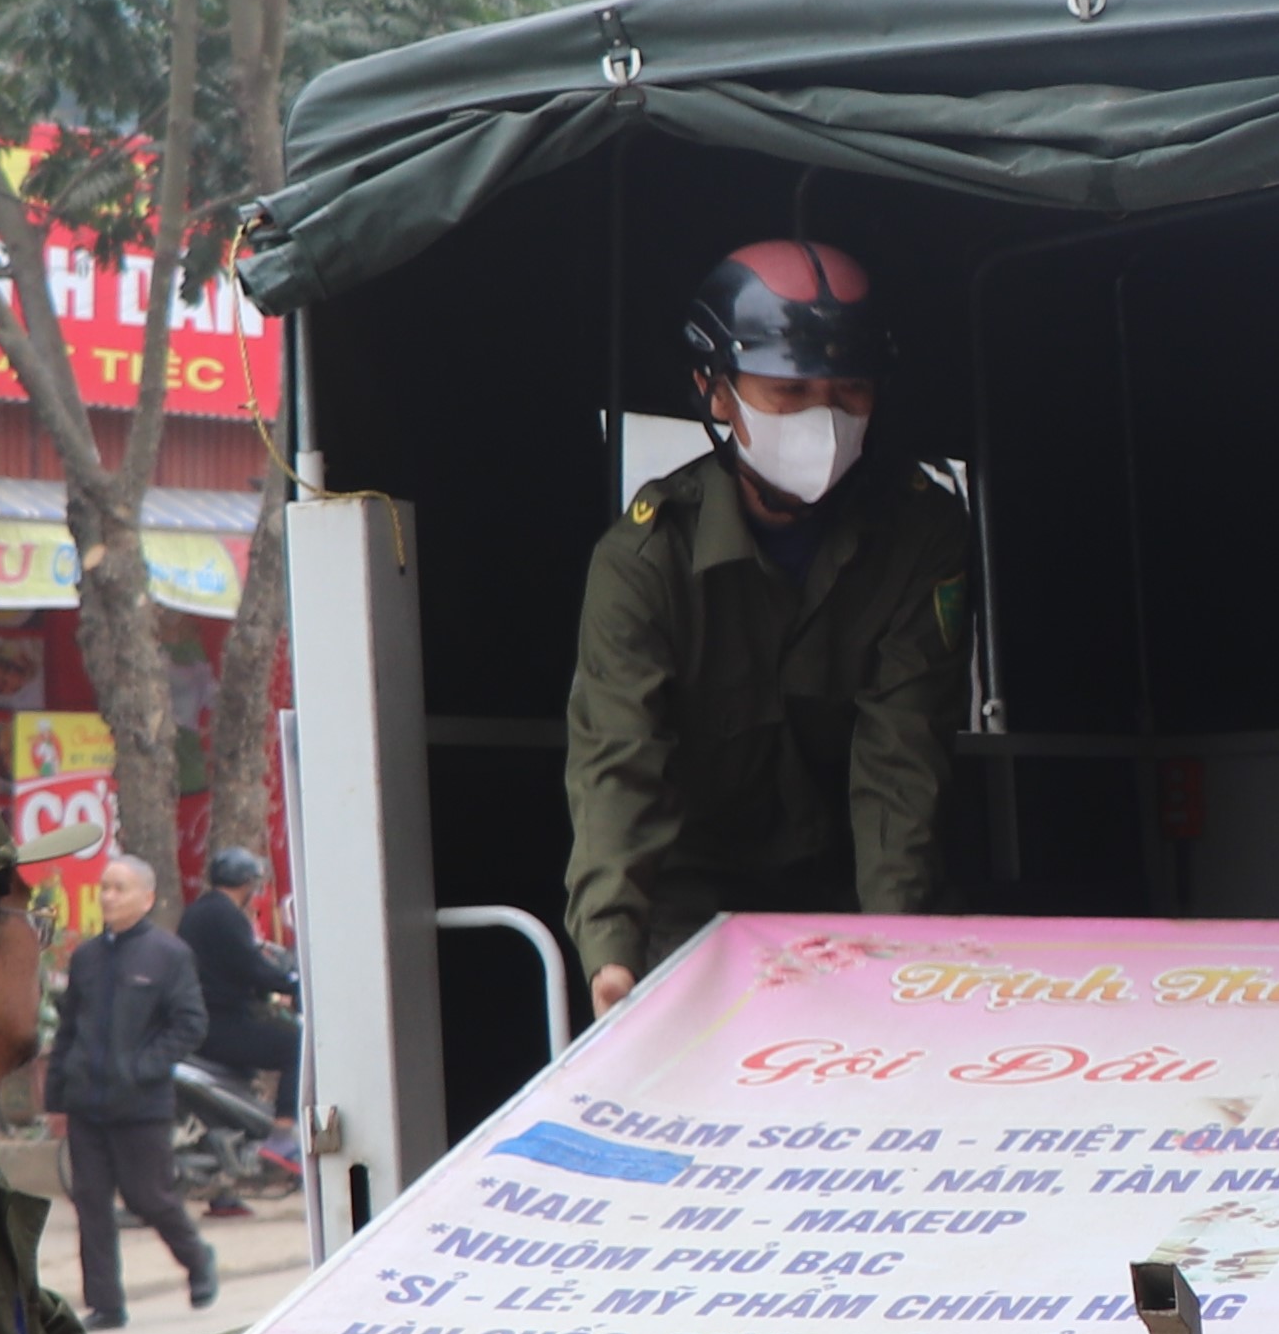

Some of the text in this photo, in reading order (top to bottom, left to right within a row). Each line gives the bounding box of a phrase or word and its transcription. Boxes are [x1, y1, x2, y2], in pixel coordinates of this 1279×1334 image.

[894, 961, 1135, 1010] Trịnh
[736, 1038, 926, 1086] Gội
[748, 1121, 861, 1152] SÓC
[867, 1128, 943, 1153] DA
[995, 1124, 1145, 1159] TRIỆT
[670, 1164, 765, 1195] TRỊ
[1089, 1164, 1202, 1194] TÀN
[660, 1207, 744, 1233] MI
[784, 1209, 1028, 1235] MAKEUP
[656, 1241, 781, 1275] PHỦ
[782, 1249, 906, 1281] BẠC
[592, 1285, 698, 1317] MỸ
[695, 1284, 879, 1320] PHẨM
[882, 1289, 1073, 1321] CHÍNH
